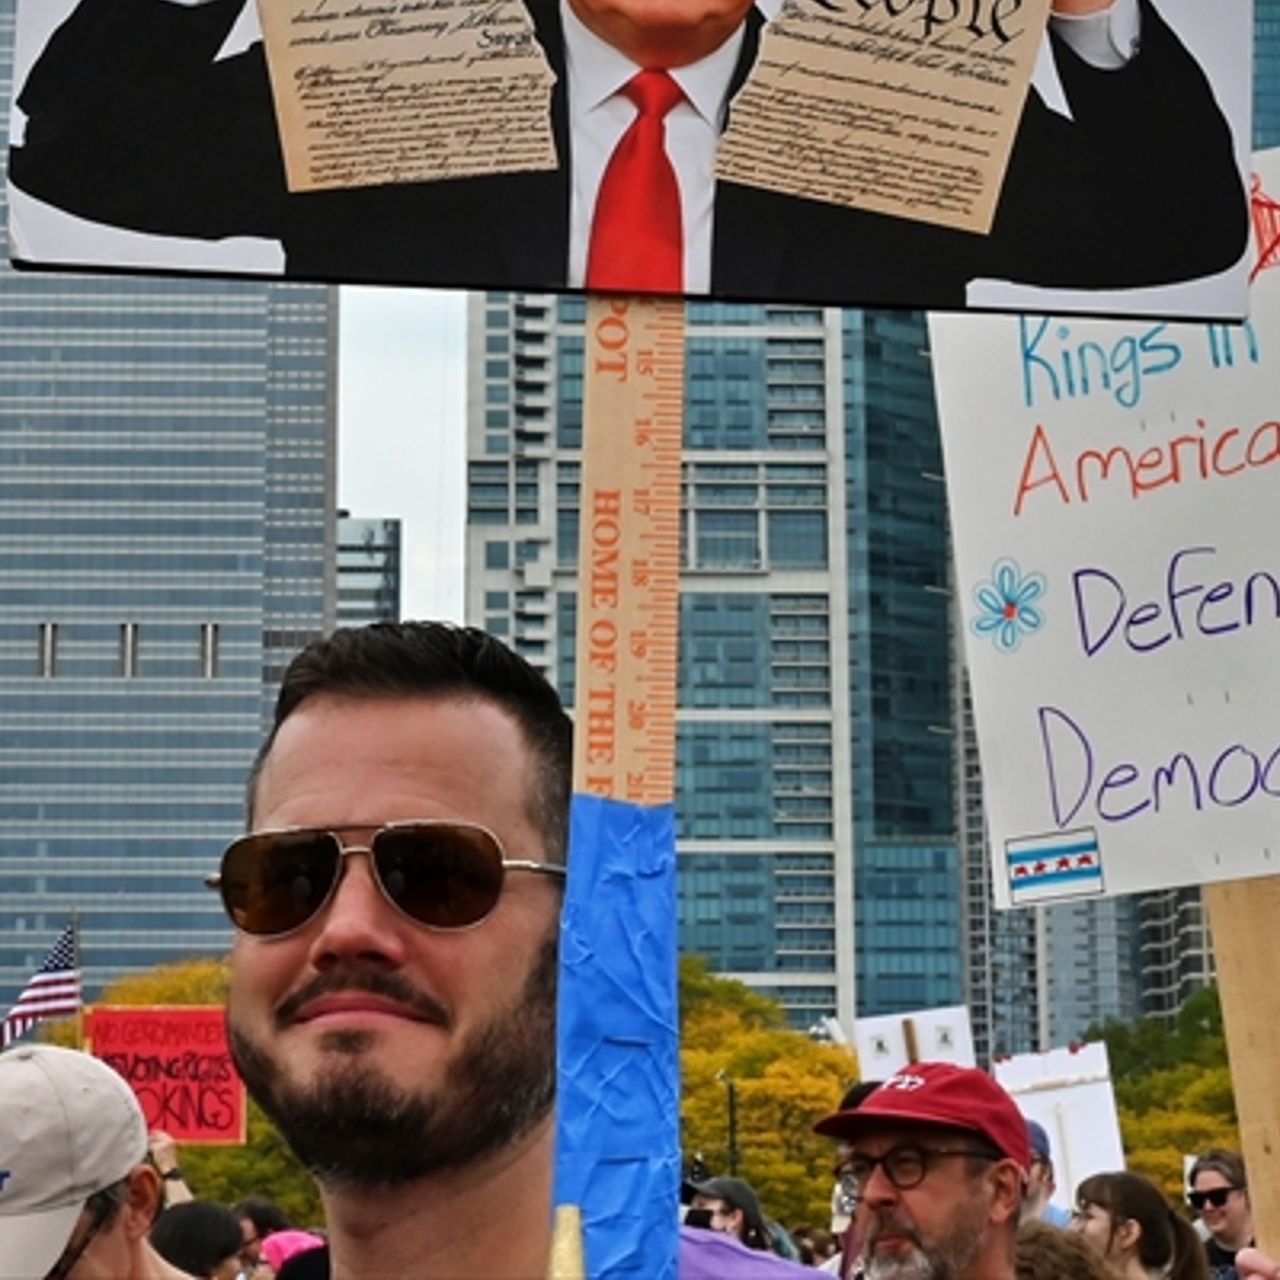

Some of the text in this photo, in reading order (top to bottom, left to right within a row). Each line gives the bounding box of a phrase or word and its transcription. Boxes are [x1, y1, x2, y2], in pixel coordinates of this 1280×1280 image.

[1020, 315, 1259, 407] Kings in
[591, 489, 623, 610] HOME
[588, 619, 619, 674] OF
[586, 683, 618, 766] THE
